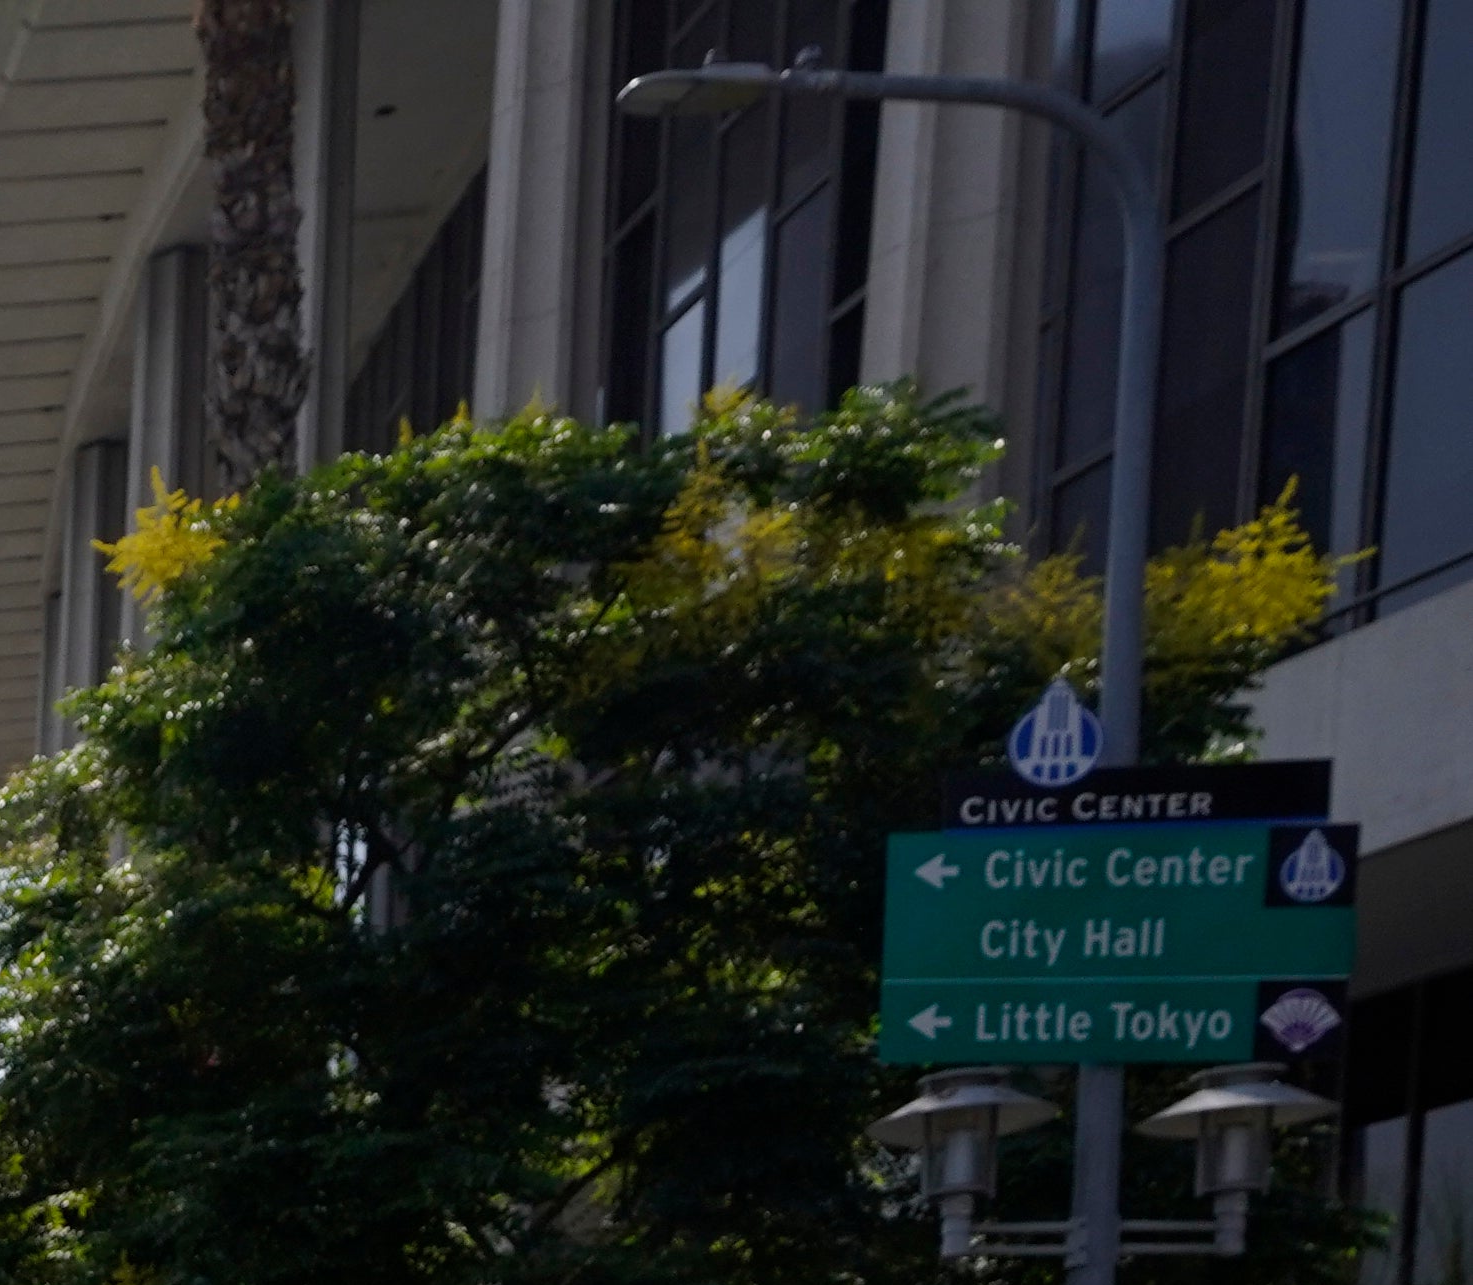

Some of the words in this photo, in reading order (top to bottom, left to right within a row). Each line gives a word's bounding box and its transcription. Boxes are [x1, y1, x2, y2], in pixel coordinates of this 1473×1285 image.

[959, 795, 1060, 825] CIVIC
[1071, 791, 1215, 822] CENTER
[984, 847, 1089, 889] Civic
[1105, 845, 1255, 888] Center
[980, 918, 1067, 967] City
[1083, 916, 1166, 959] Hall
[975, 1001, 1093, 1042] Little
[1108, 1000, 1234, 1050] Tokyo
